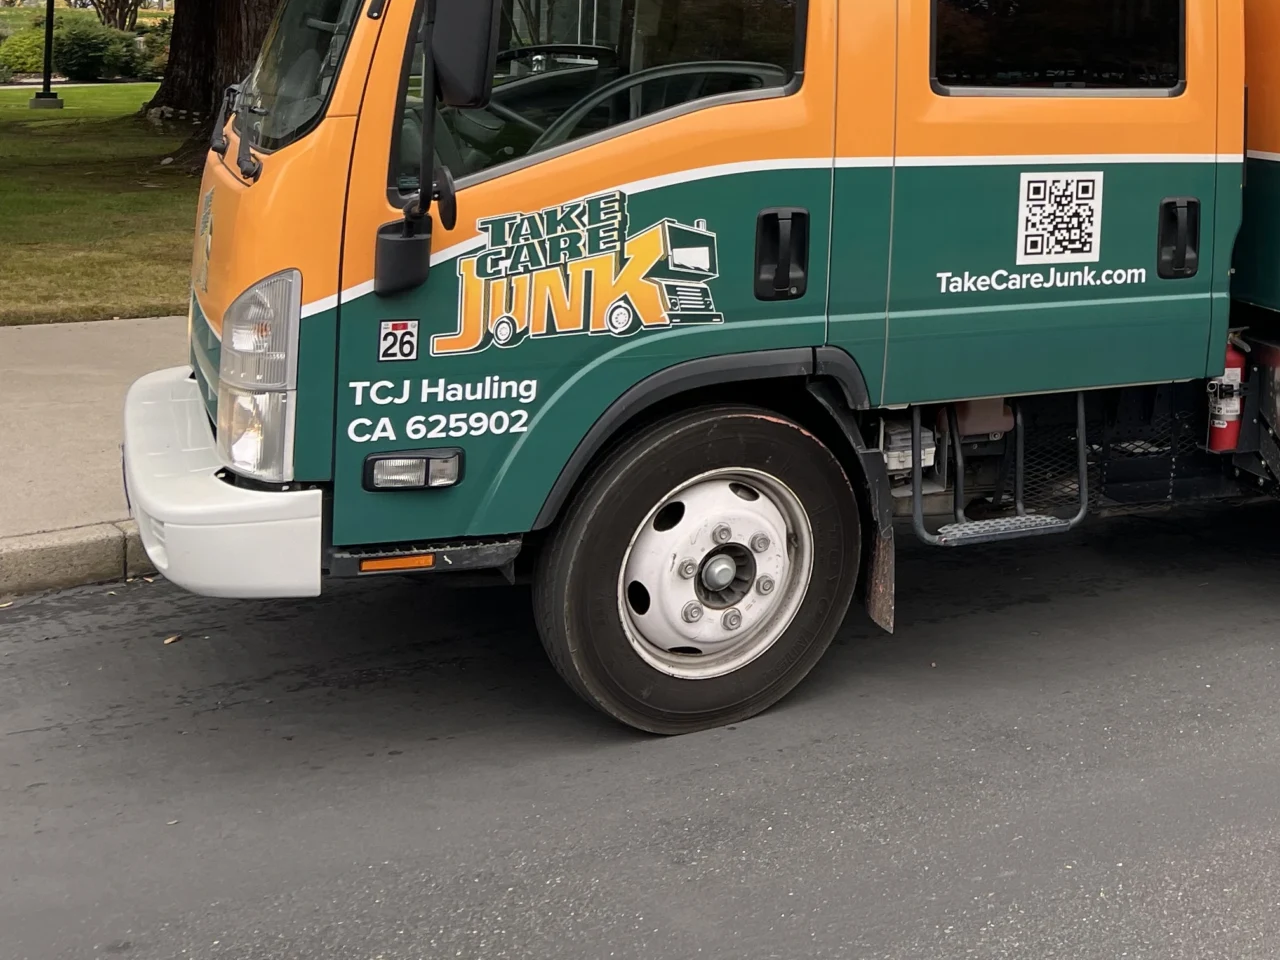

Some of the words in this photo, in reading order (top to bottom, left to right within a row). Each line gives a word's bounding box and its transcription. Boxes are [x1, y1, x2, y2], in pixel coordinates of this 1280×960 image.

[476, 190, 626, 250] TAKE
[474, 219, 626, 279] CARE
[430, 218, 671, 356] JUNK
[936, 266, 1146, 293] TakeCareJunk.com
[381, 331, 415, 358] 26
[348, 379, 411, 406] TCJ
[420, 375, 538, 404] Hauling
[347, 417, 397, 443] CA
[405, 409, 529, 440] 625902
